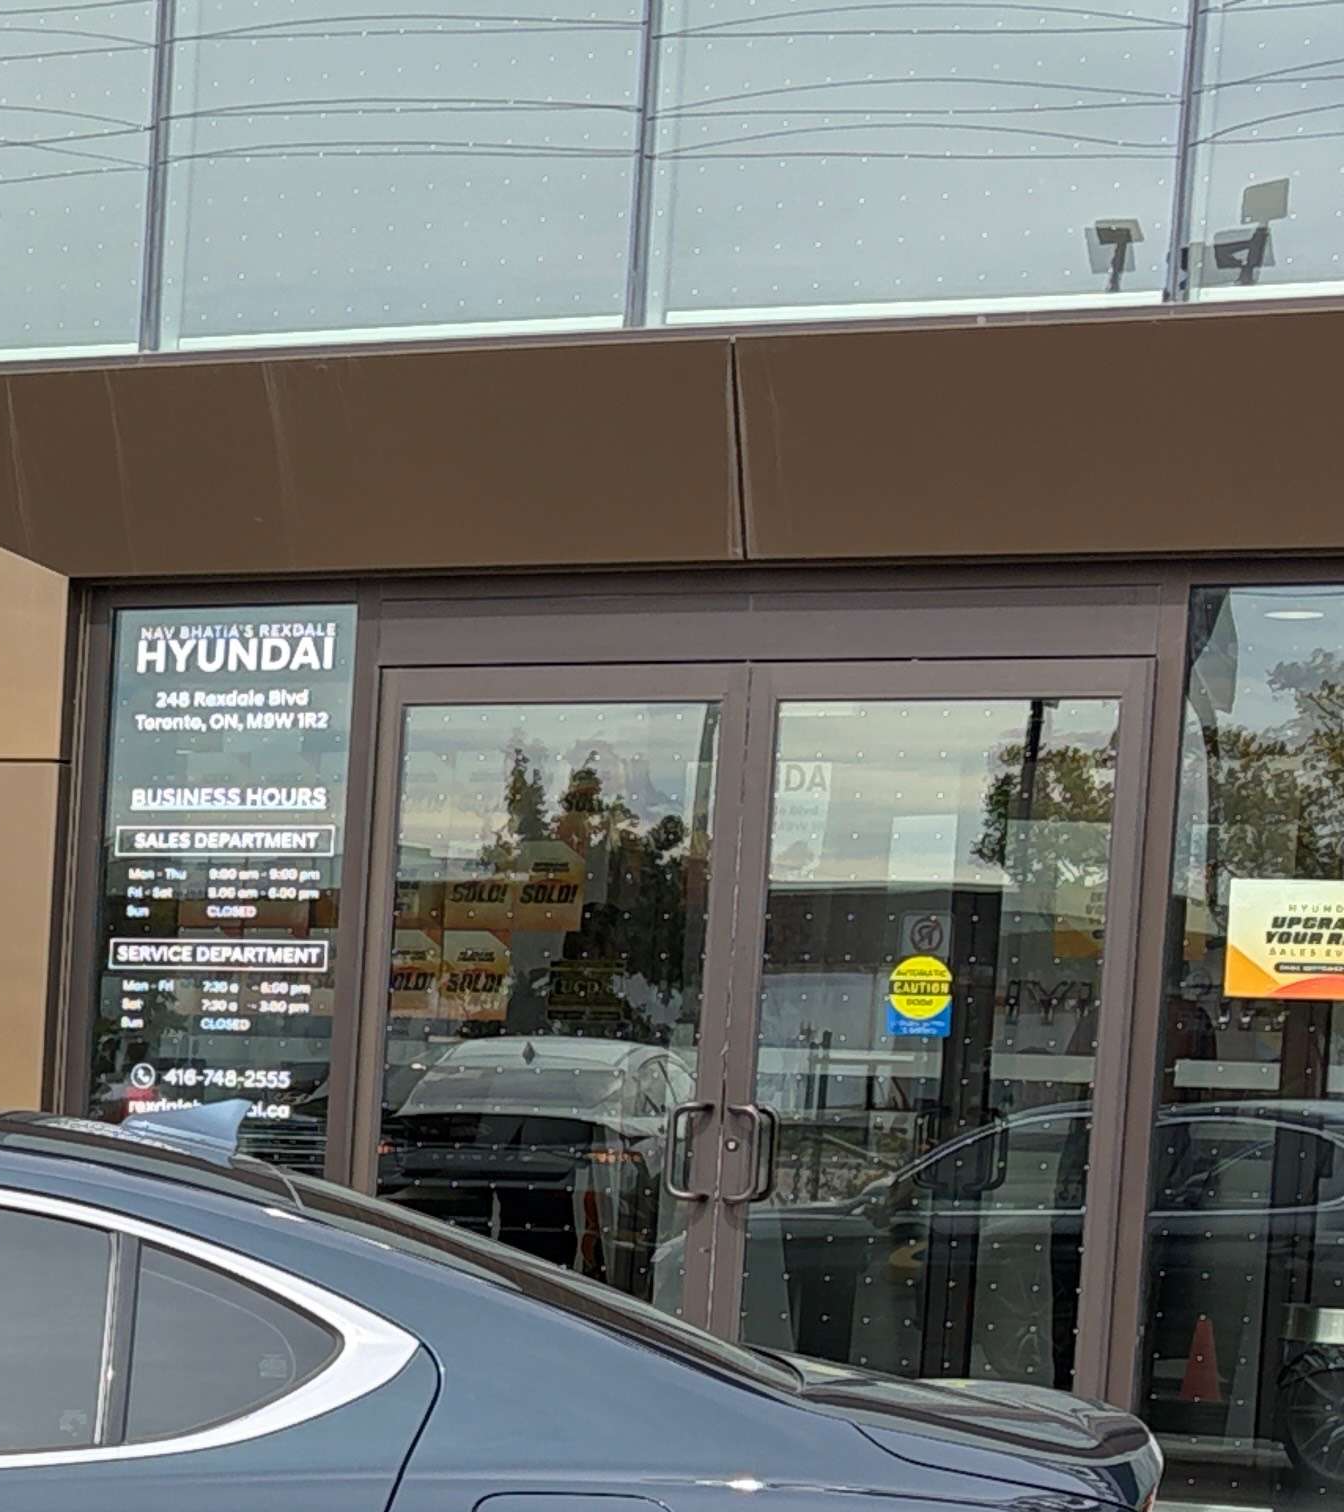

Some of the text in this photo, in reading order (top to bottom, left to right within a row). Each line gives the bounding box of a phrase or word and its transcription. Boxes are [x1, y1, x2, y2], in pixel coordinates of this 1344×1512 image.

[141, 623, 336, 641] NAV BHATIA'S REXDALE
[137, 637, 334, 673] HYUNDAI
[194, 690, 265, 707] Rexdale
[269, 689, 309, 706] Blvd
[135, 712, 329, 732] Toronto, ON, M9W 1R2
[131, 787, 327, 808] BUSINESS HOURS
[134, 832, 319, 849] SALES DEPARTMENT
[128, 868, 154, 880] Mon
[164, 868, 187, 880] Thu
[299, 870, 320, 883] pm
[127, 886, 143, 898] Fri
[152, 886, 173, 898] Sat
[298, 889, 319, 901] pm
[520, 884, 578, 904] SOLD!
[126, 905, 256, 918] Sun CLOSED
[1265, 930, 1344, 945] YOUR R
[116, 945, 321, 963] SERVICE DEPARTMENT
[1268, 947, 1317, 957] SALES
[122, 980, 149, 992] Mon
[158, 980, 174, 992] Fri
[289, 983, 311, 996] pm
[393, 972, 435, 992] OLD!
[446, 972, 503, 993] SOLD!
[893, 981, 949, 994] CAUTION
[121, 998, 143, 1010] Sat
[288, 1002, 310, 1015] pm
[121, 1016, 251, 1031] Sun CLOSED
[162, 1068, 291, 1089] 416-748-2555
